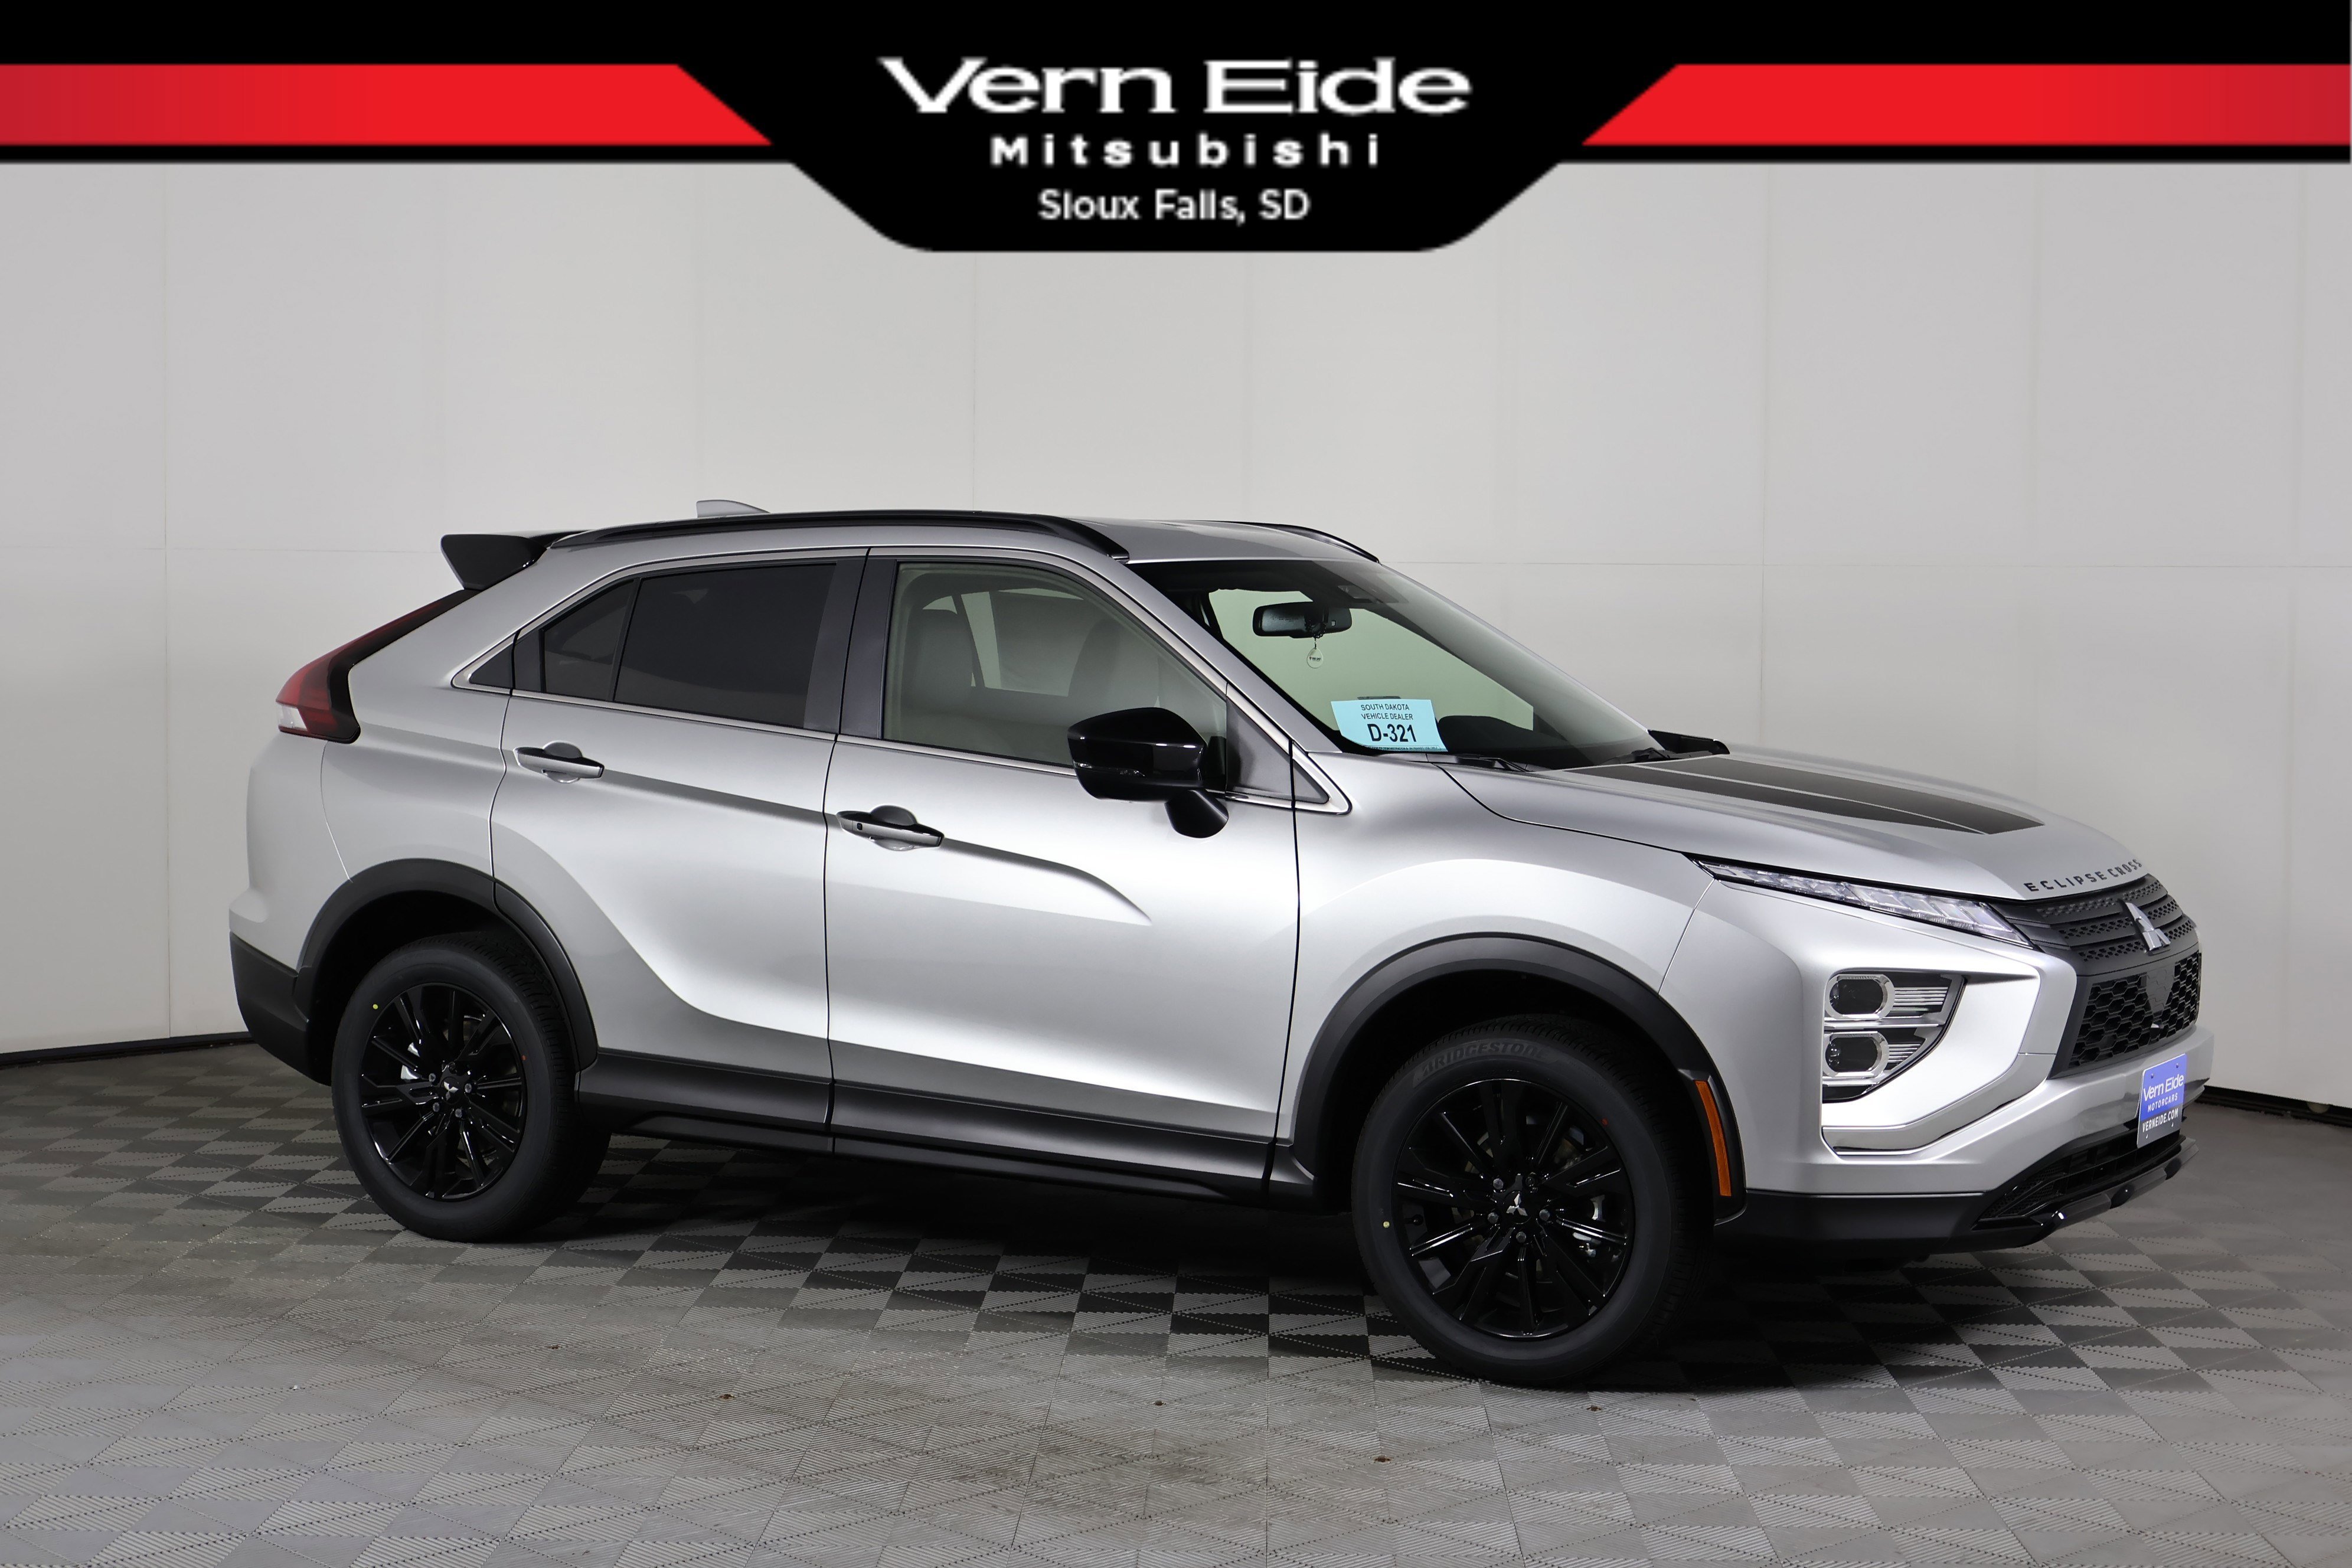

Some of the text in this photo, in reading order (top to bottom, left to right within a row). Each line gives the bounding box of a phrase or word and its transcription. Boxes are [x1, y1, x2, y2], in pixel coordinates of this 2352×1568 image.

[1367, 723, 1416, 742] D-321
[2023, 858, 2142, 891] ECLIPSE CROSS
[2143, 1073, 2184, 1101] Vern Eide
[2147, 1092, 2178, 1112] MOTORCARS
[2142, 1108, 2178, 1132] VERNEIDE.COM
